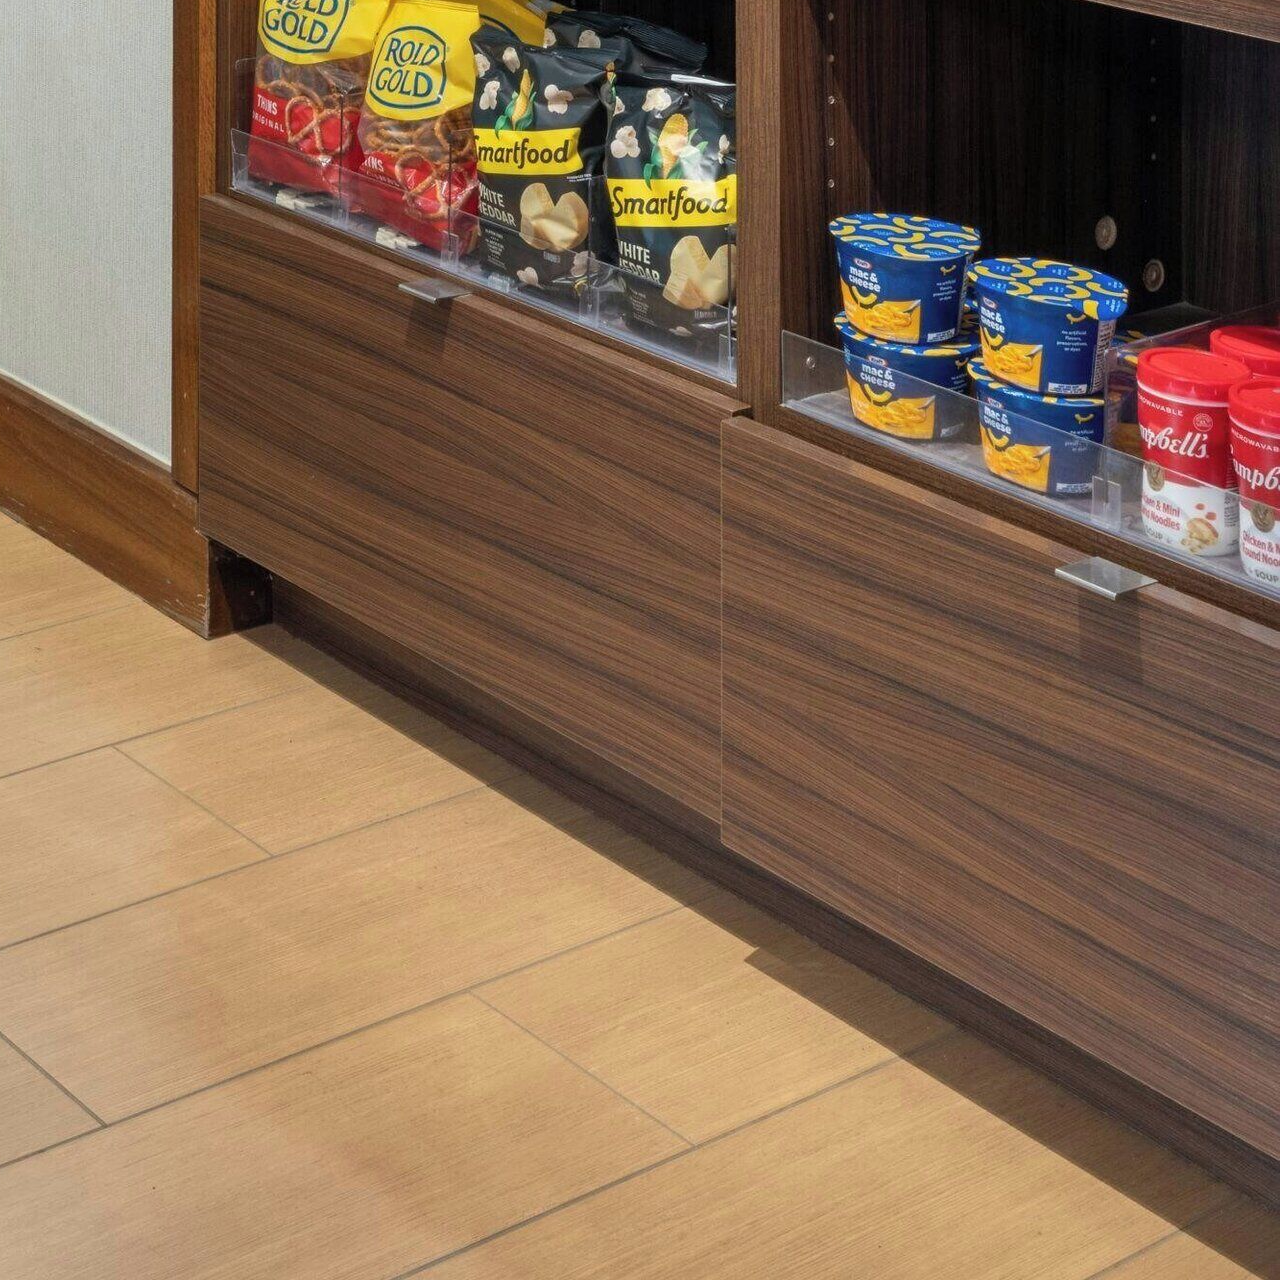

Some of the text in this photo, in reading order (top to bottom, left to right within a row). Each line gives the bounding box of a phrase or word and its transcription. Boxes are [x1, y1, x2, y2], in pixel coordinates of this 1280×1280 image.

[265, 8, 329, 44] GOLD
[384, 38, 440, 67] ROLD
[375, 68, 433, 97] GOLD
[257, 94, 278, 115] THINS
[476, 138, 569, 169] martfood
[611, 185, 728, 221] Smartfood
[479, 202, 517, 228] EDDAR
[849, 266, 878, 283] mac &
[980, 307, 1003, 324] mac &
[861, 364, 893, 380] mac &
[984, 406, 1009, 424] mac &
[1139, 424, 1209, 459] mpbell's
[1231, 428, 1280, 452] MICROWAVAB
[1162, 502, 1181, 518] Mini
[1151, 512, 1181, 531] Noodles
[1242, 529, 1266, 550] Chicken
